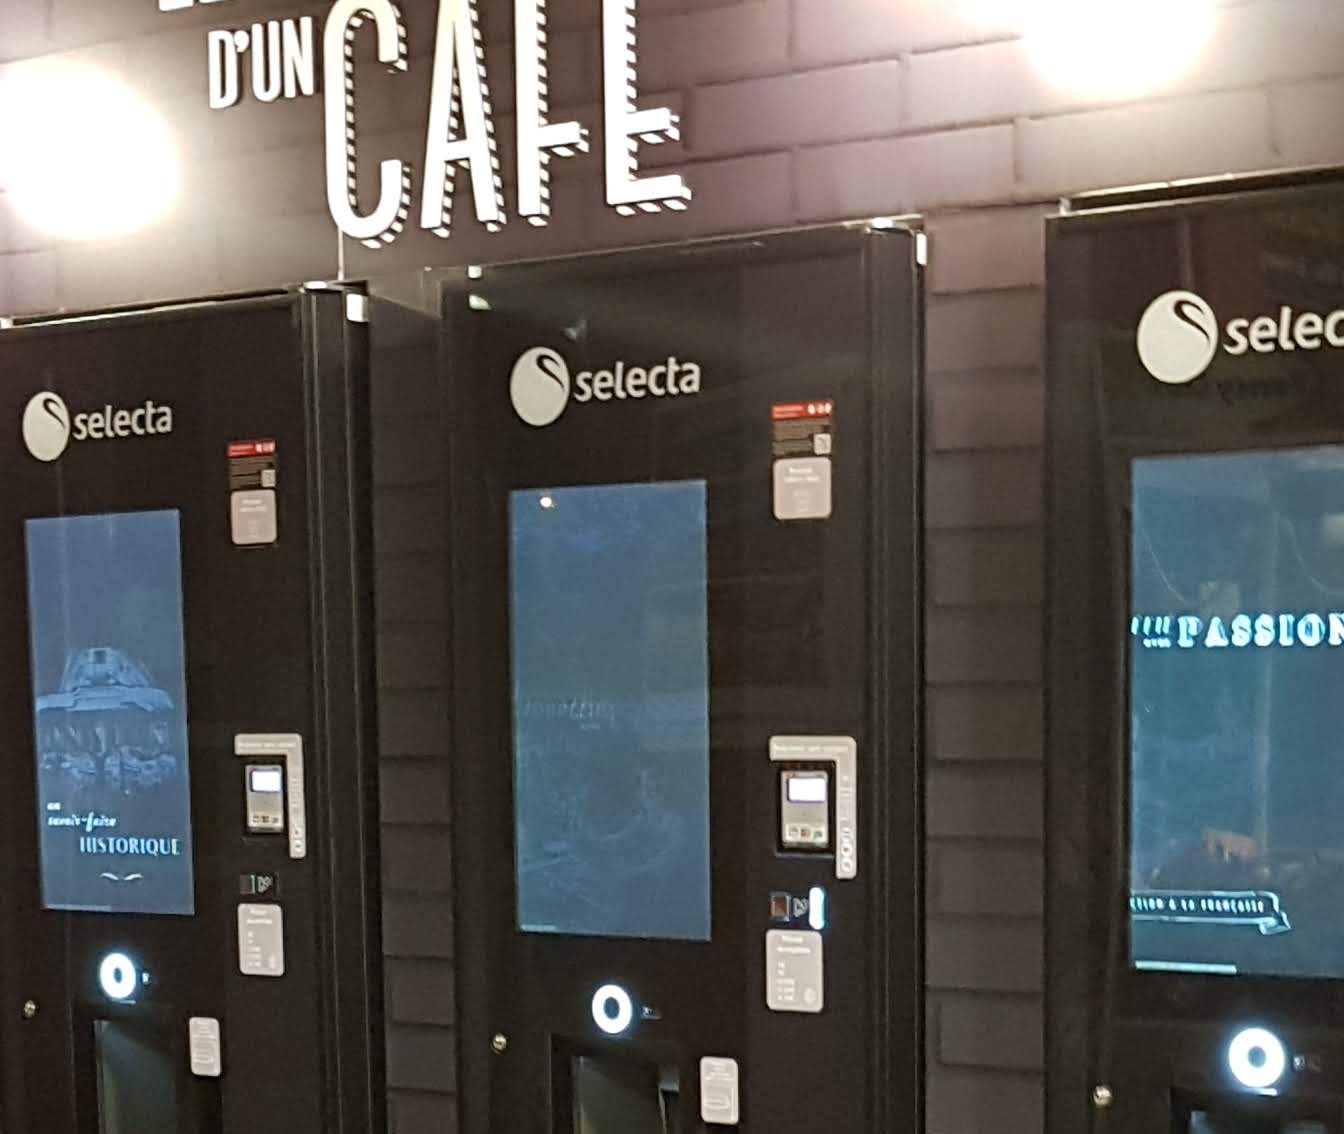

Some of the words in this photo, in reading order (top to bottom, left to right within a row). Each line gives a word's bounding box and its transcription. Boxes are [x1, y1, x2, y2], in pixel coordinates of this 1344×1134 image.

[573, 357, 702, 402] selecta
[72, 400, 173, 440] selecta
[79, 836, 181, 857] HISTORIQUE
